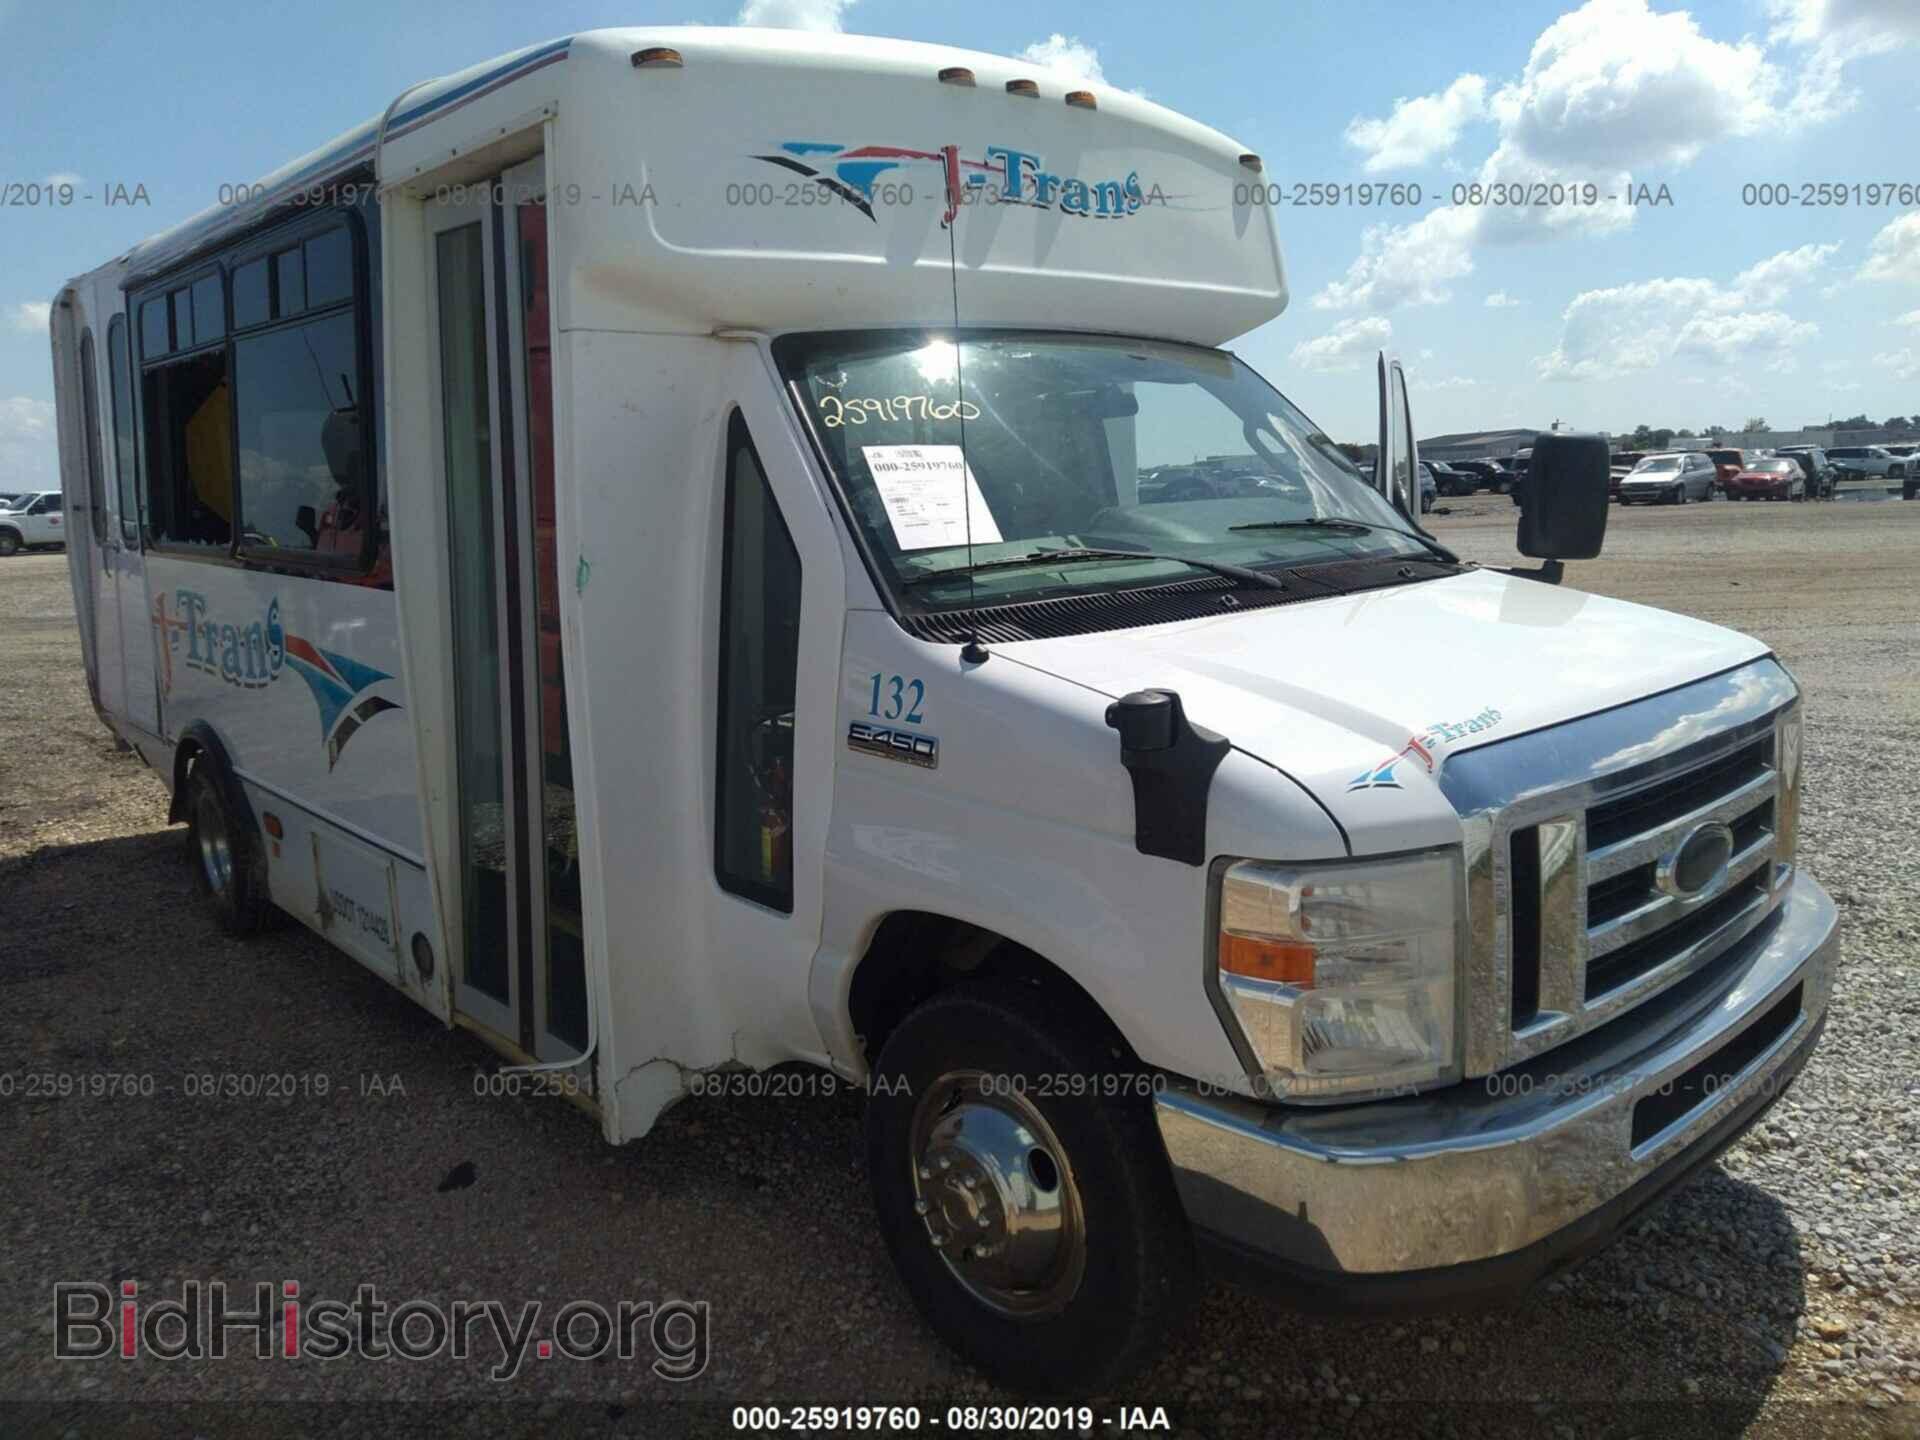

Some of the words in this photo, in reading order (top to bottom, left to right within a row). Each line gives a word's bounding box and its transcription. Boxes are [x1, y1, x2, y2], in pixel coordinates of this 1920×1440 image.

[940, 144, 1143, 229] J-Trans
[820, 395, 980, 428] 25919760
[874, 461, 963, 473] 000-25919760
[869, 671, 925, 724] 132
[1407, 705, 1503, 774] J-Trans
